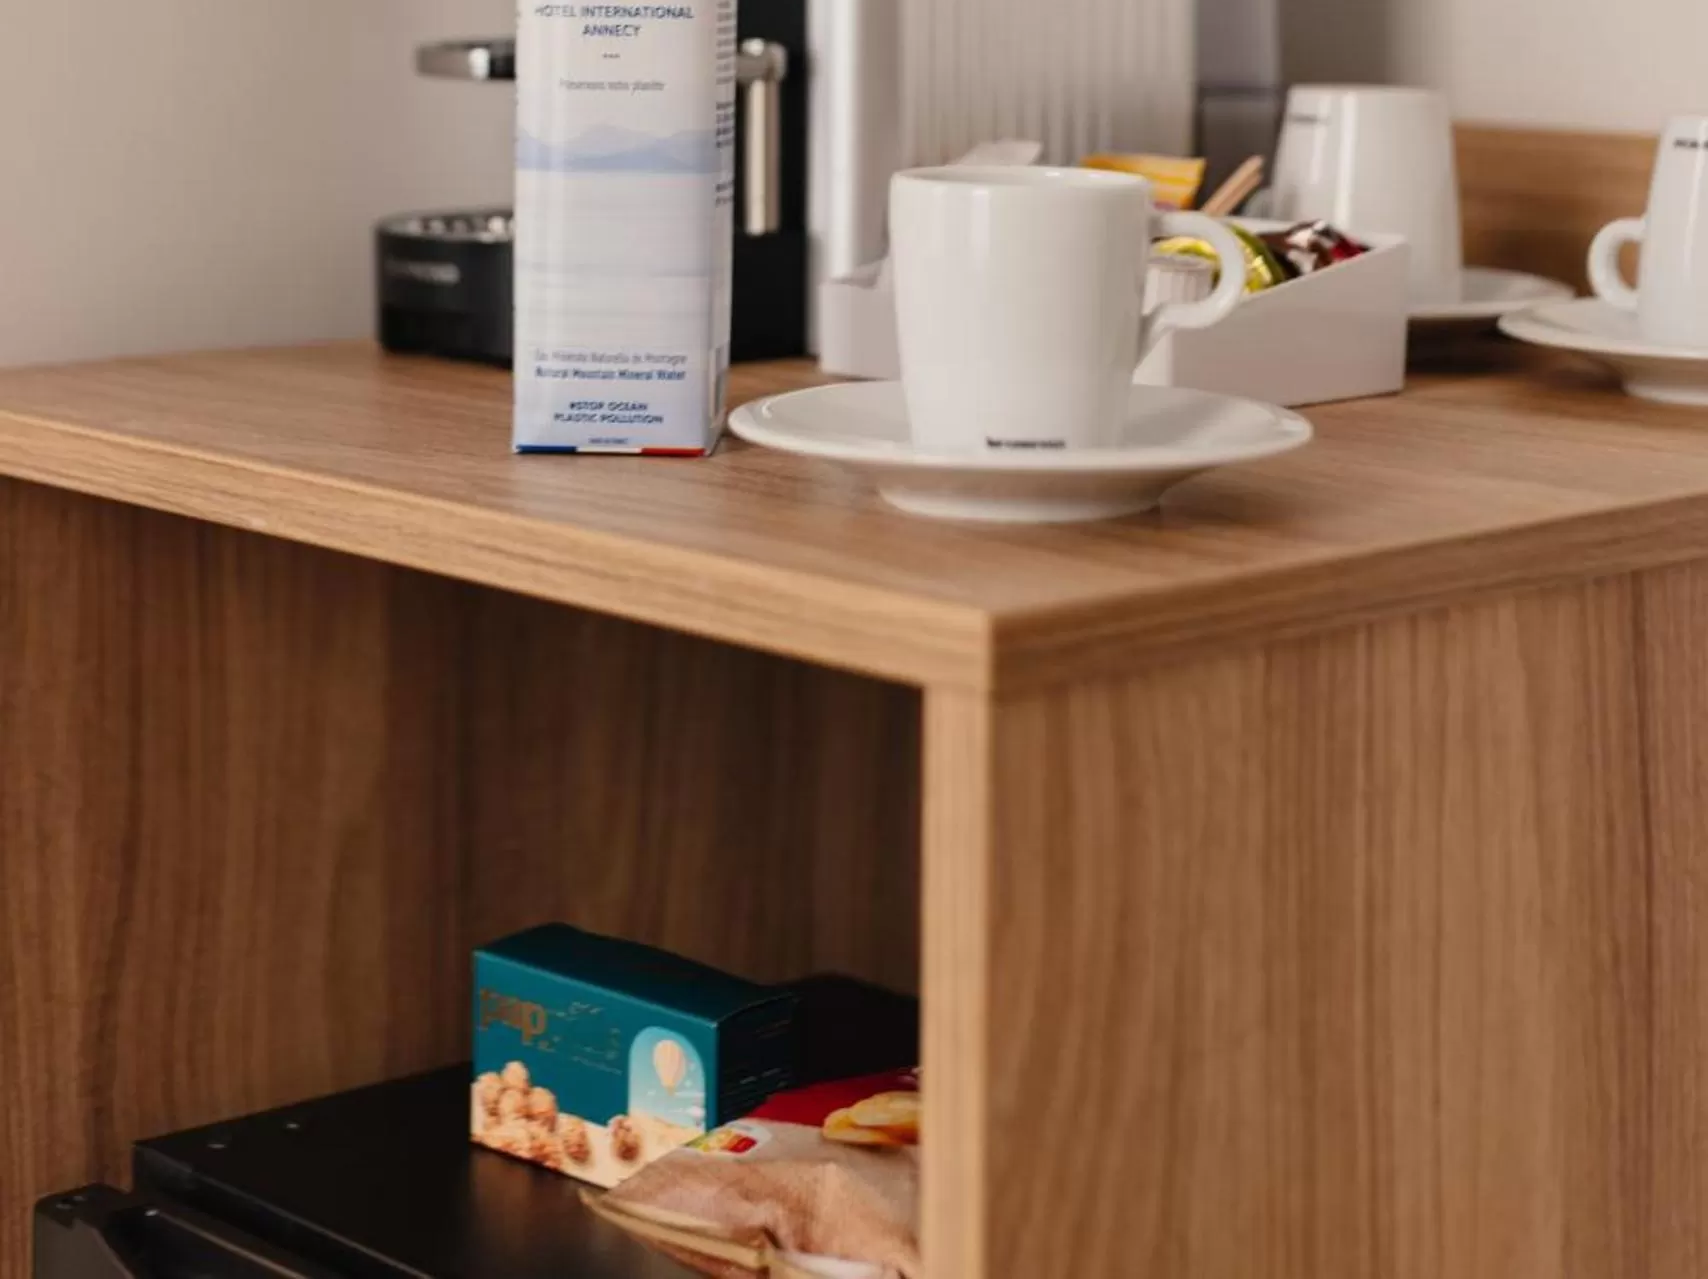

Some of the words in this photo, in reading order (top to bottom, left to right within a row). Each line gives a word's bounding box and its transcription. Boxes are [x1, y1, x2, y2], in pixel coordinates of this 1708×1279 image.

[534, 4, 577, 18] HOTEL
[580, 5, 695, 19] INTERNATIONAL
[582, 24, 642, 37] ANNECY
[607, 401, 648, 411] OCEAN
[554, 413, 597, 423] PLASTIC
[600, 414, 664, 424] POLLUTION
